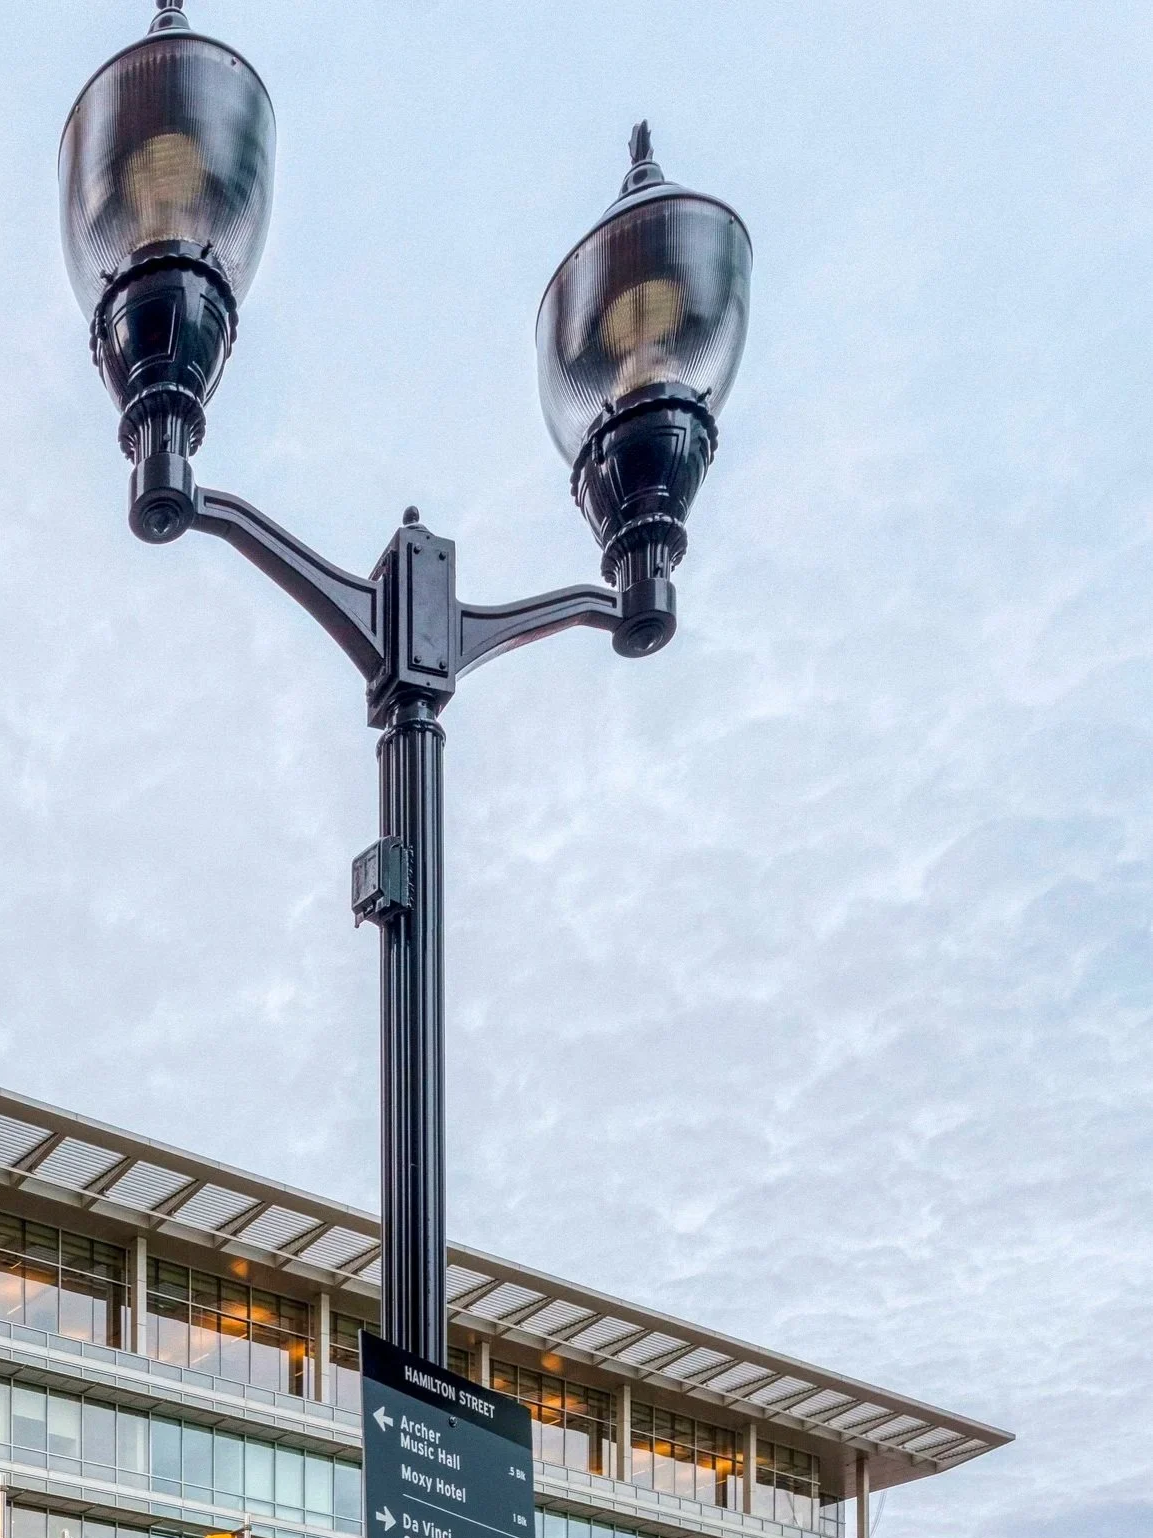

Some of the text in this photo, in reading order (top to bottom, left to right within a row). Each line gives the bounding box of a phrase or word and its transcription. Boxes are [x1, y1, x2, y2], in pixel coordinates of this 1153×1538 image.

[405, 1365, 495, 1418] HAMILTON STREET
[401, 1416, 441, 1444] Archer
[401, 1433, 460, 1470] Music Hall
[401, 1464, 465, 1503] Moxy Hotel
[516, 1469, 526, 1481] Blk
[403, 1513, 419, 1532] Da
[517, 1515, 527, 1527] Blk
